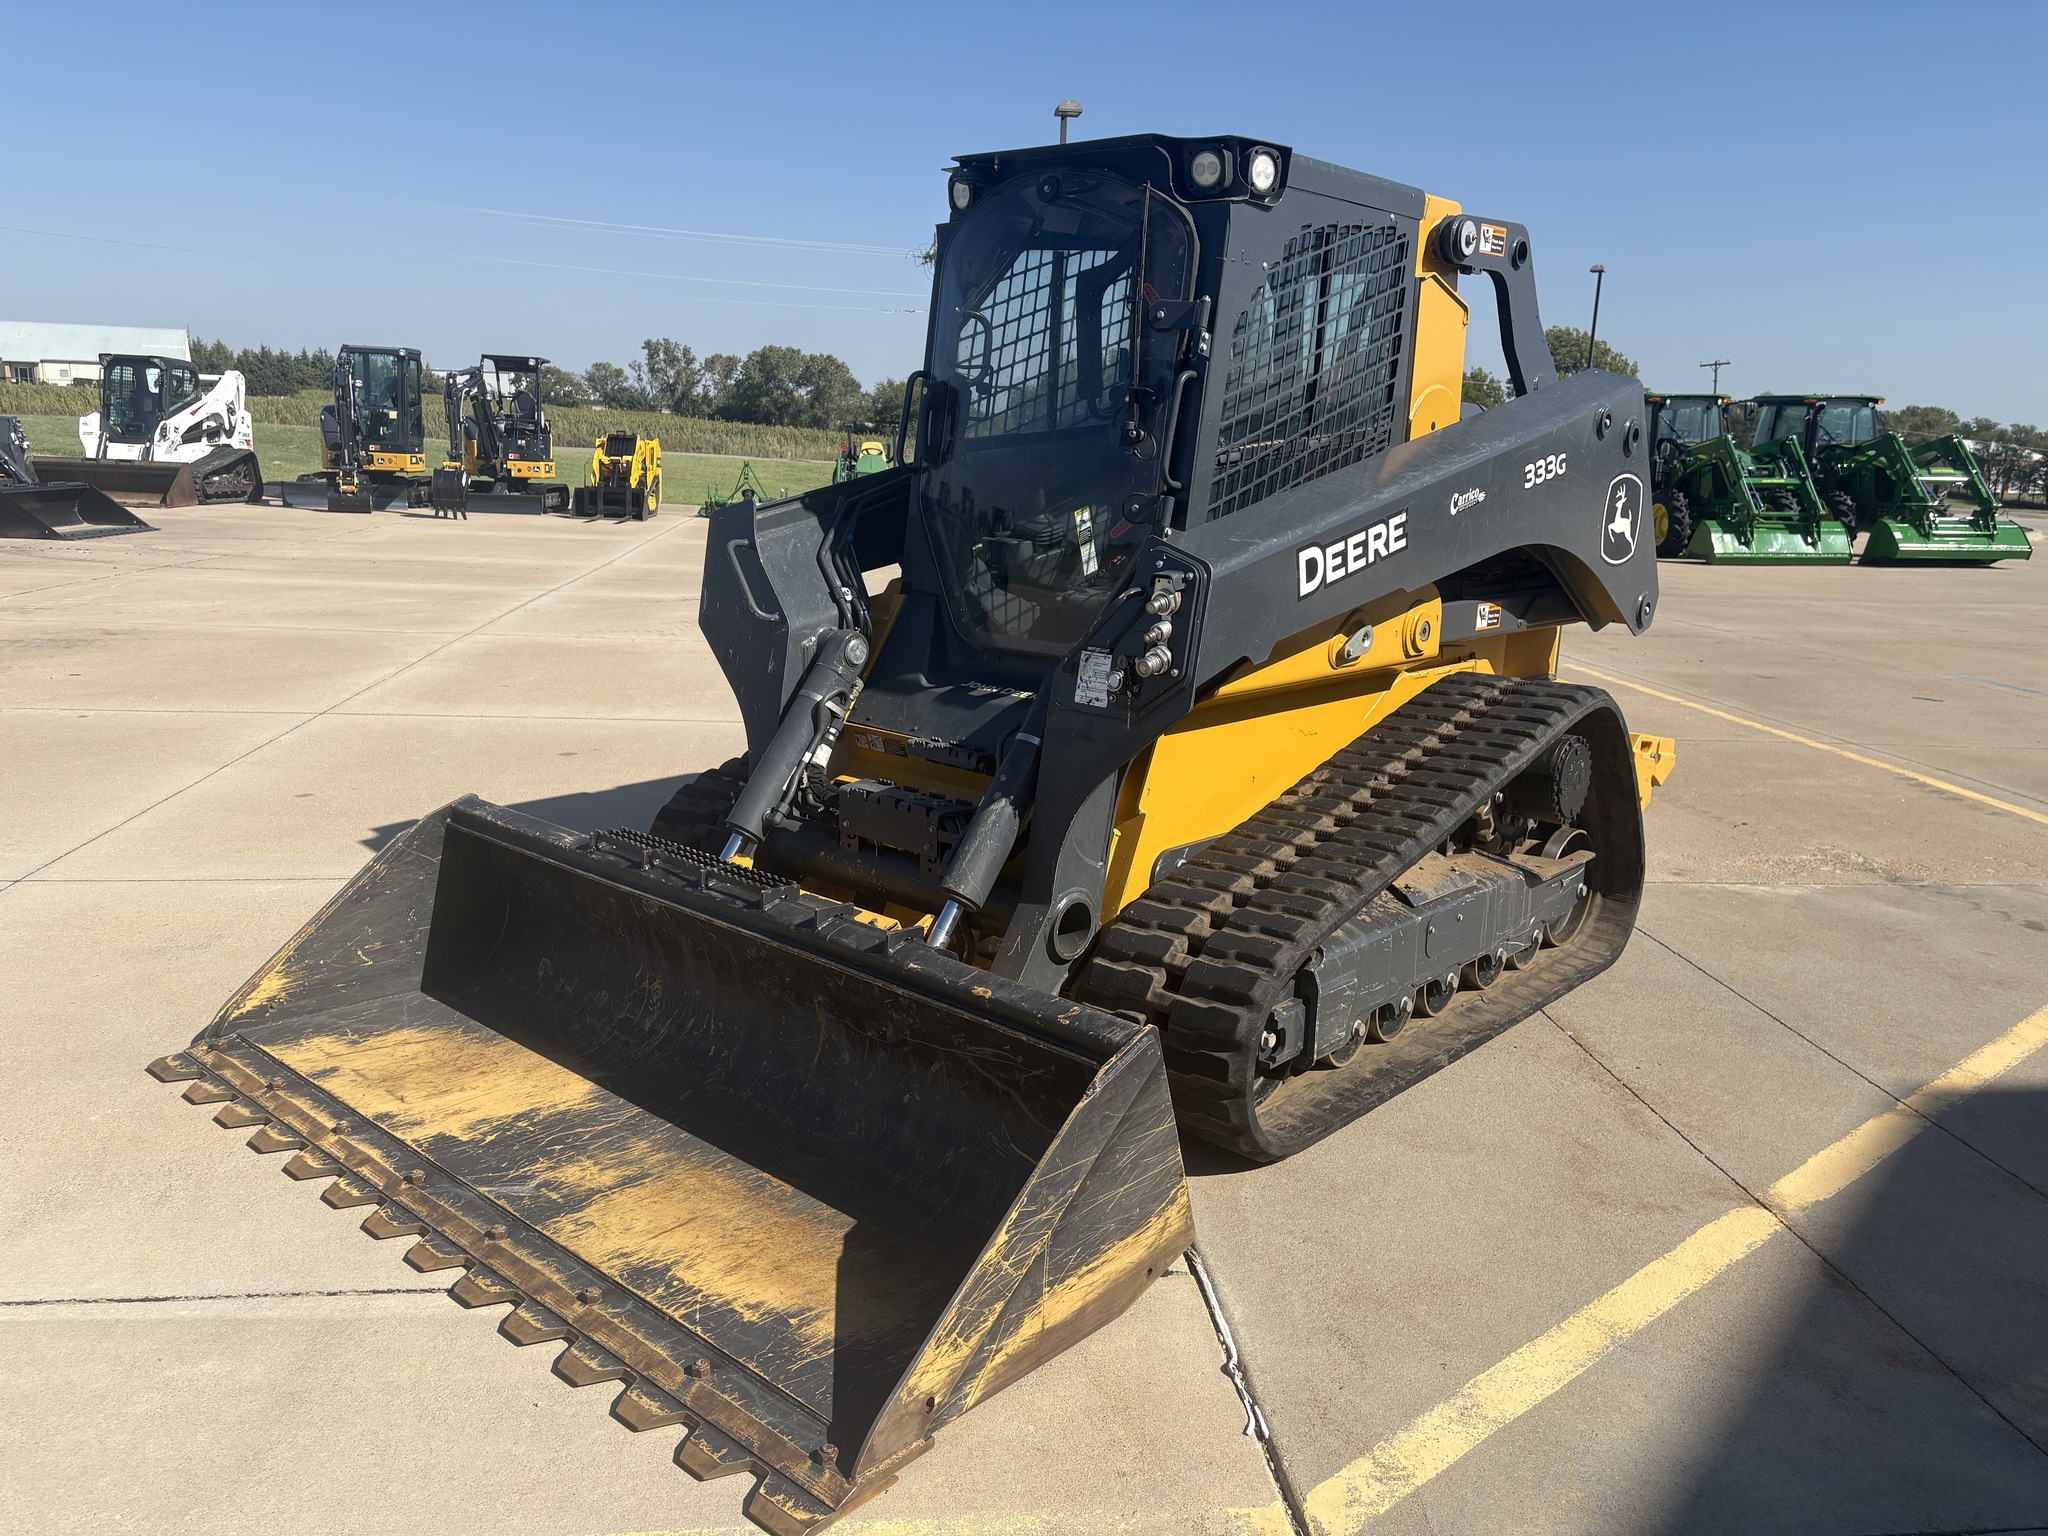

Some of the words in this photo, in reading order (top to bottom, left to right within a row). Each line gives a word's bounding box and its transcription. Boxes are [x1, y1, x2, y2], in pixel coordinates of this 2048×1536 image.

[1524, 452, 1567, 489] 333G
[1451, 487, 1480, 516] Carrico
[1298, 512, 1407, 597] DEERE
[960, 680, 1001, 693] JOHN
[1000, 687, 1038, 700] DEER
